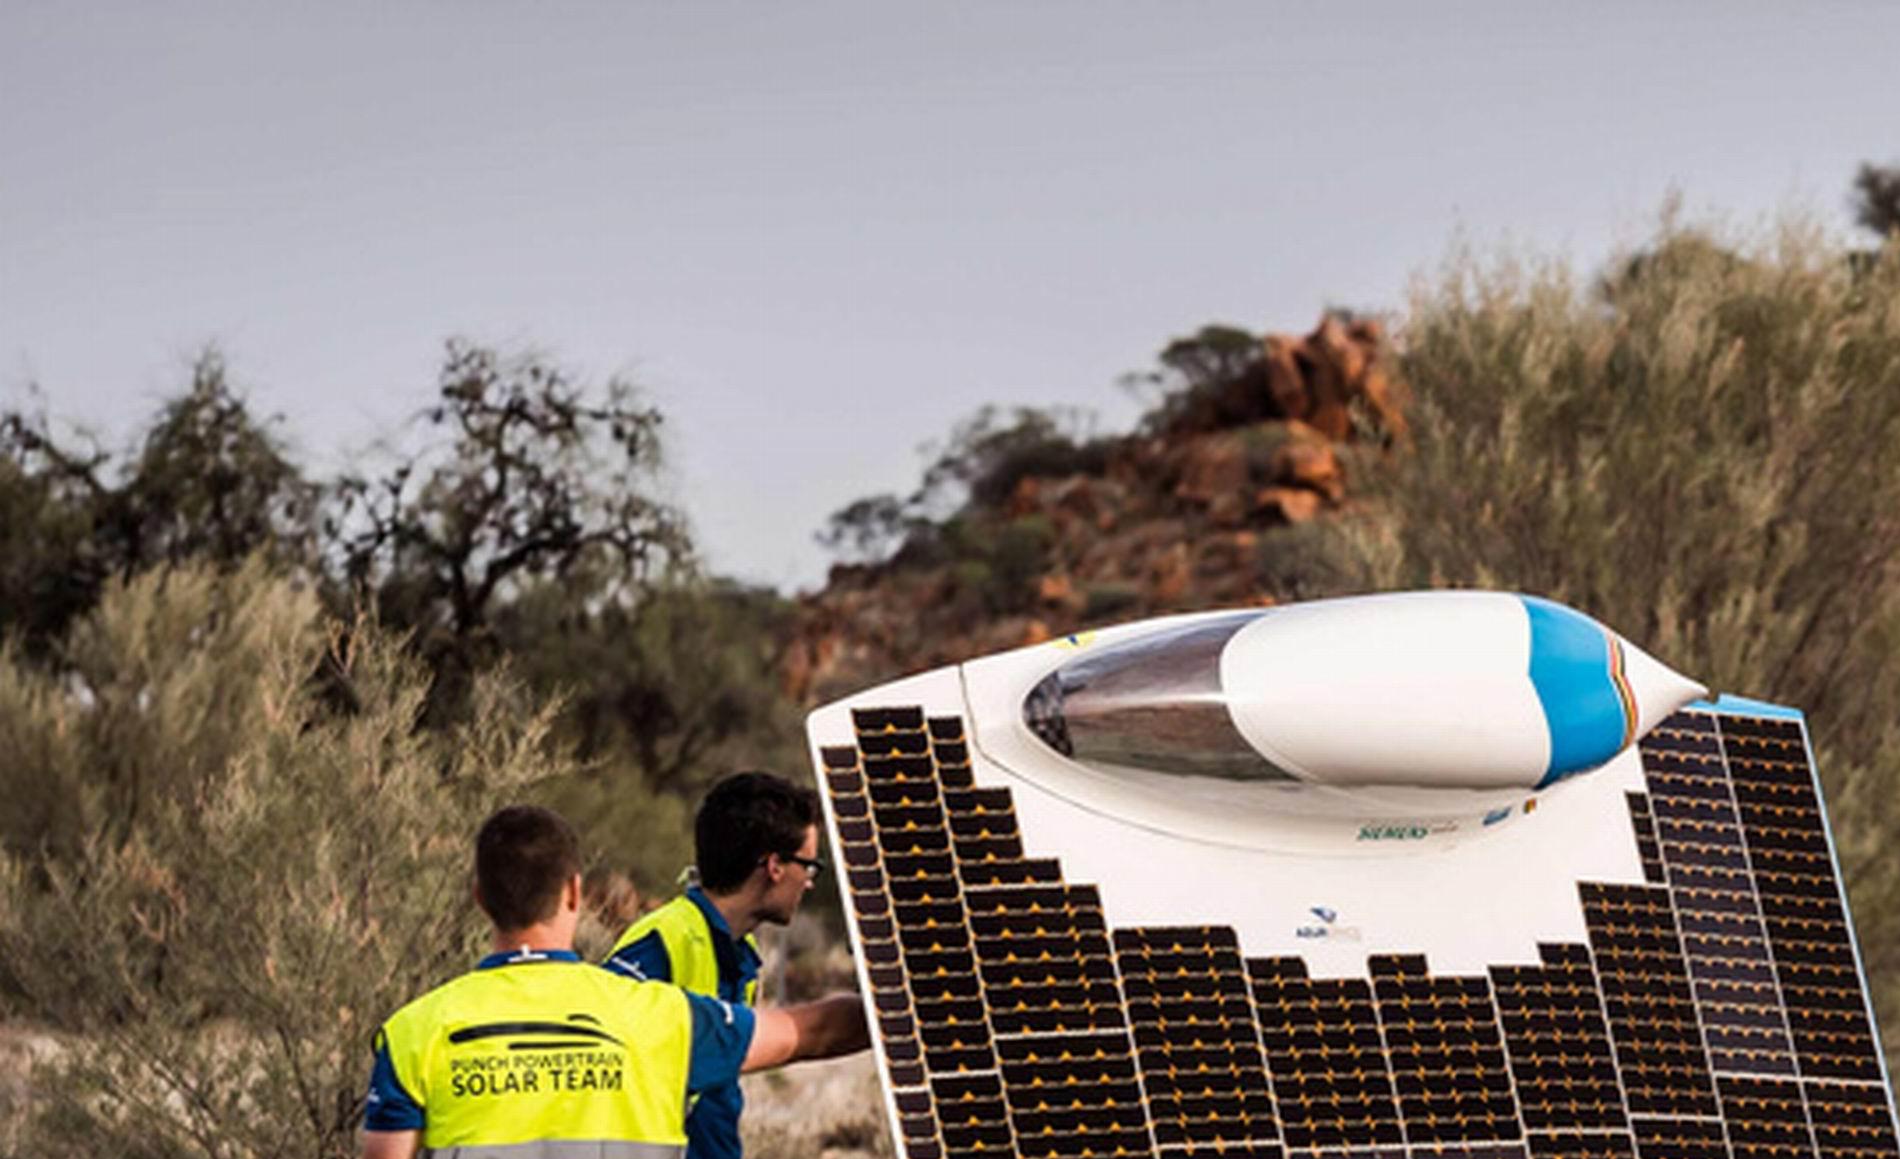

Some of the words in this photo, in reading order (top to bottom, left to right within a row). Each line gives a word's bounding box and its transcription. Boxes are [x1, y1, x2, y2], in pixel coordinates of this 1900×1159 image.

[451, 1056, 509, 1073] PUNCH
[514, 1052, 623, 1070] POWERTRAIN
[451, 1070, 538, 1097] SOLAR
[549, 1069, 623, 1091] TEAM
